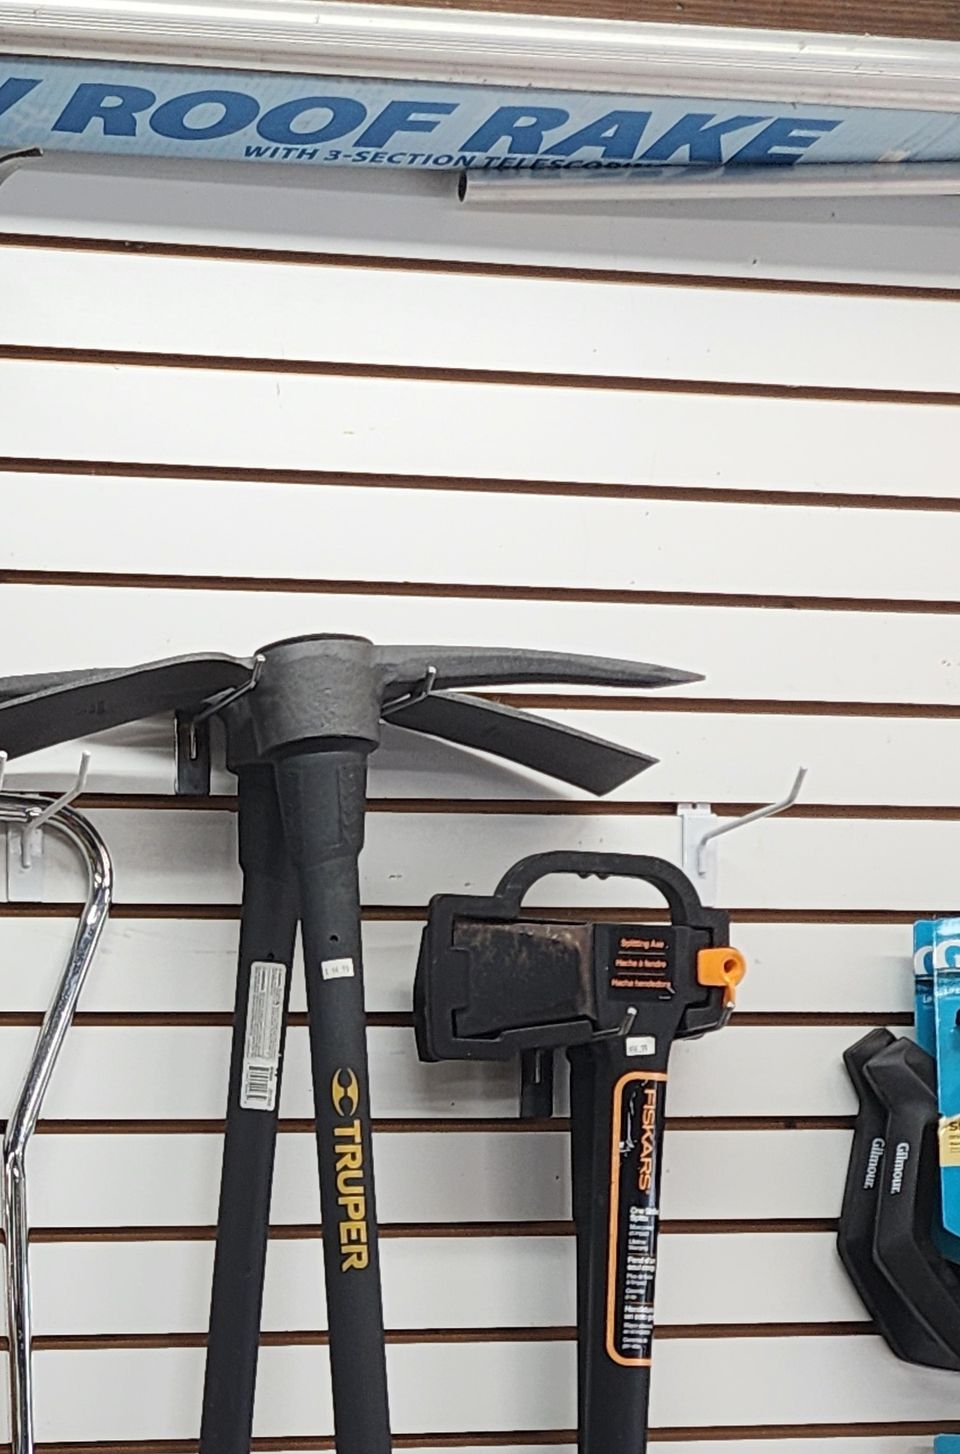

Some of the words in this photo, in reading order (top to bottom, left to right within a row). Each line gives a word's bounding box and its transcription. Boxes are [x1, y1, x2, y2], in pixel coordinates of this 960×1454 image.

[51, 82, 460, 149] ROOF
[468, 104, 844, 168] RAKE
[243, 144, 319, 163] WITH
[323, 147, 473, 170] 3-SECTION
[650, 939, 665, 948] Axe
[637, 1088, 658, 1192] FISKARS
[863, 1137, 886, 1190] Gilmour
[890, 1142, 910, 1195] Gilmour
[331, 1119, 370, 1273] TRUPER
